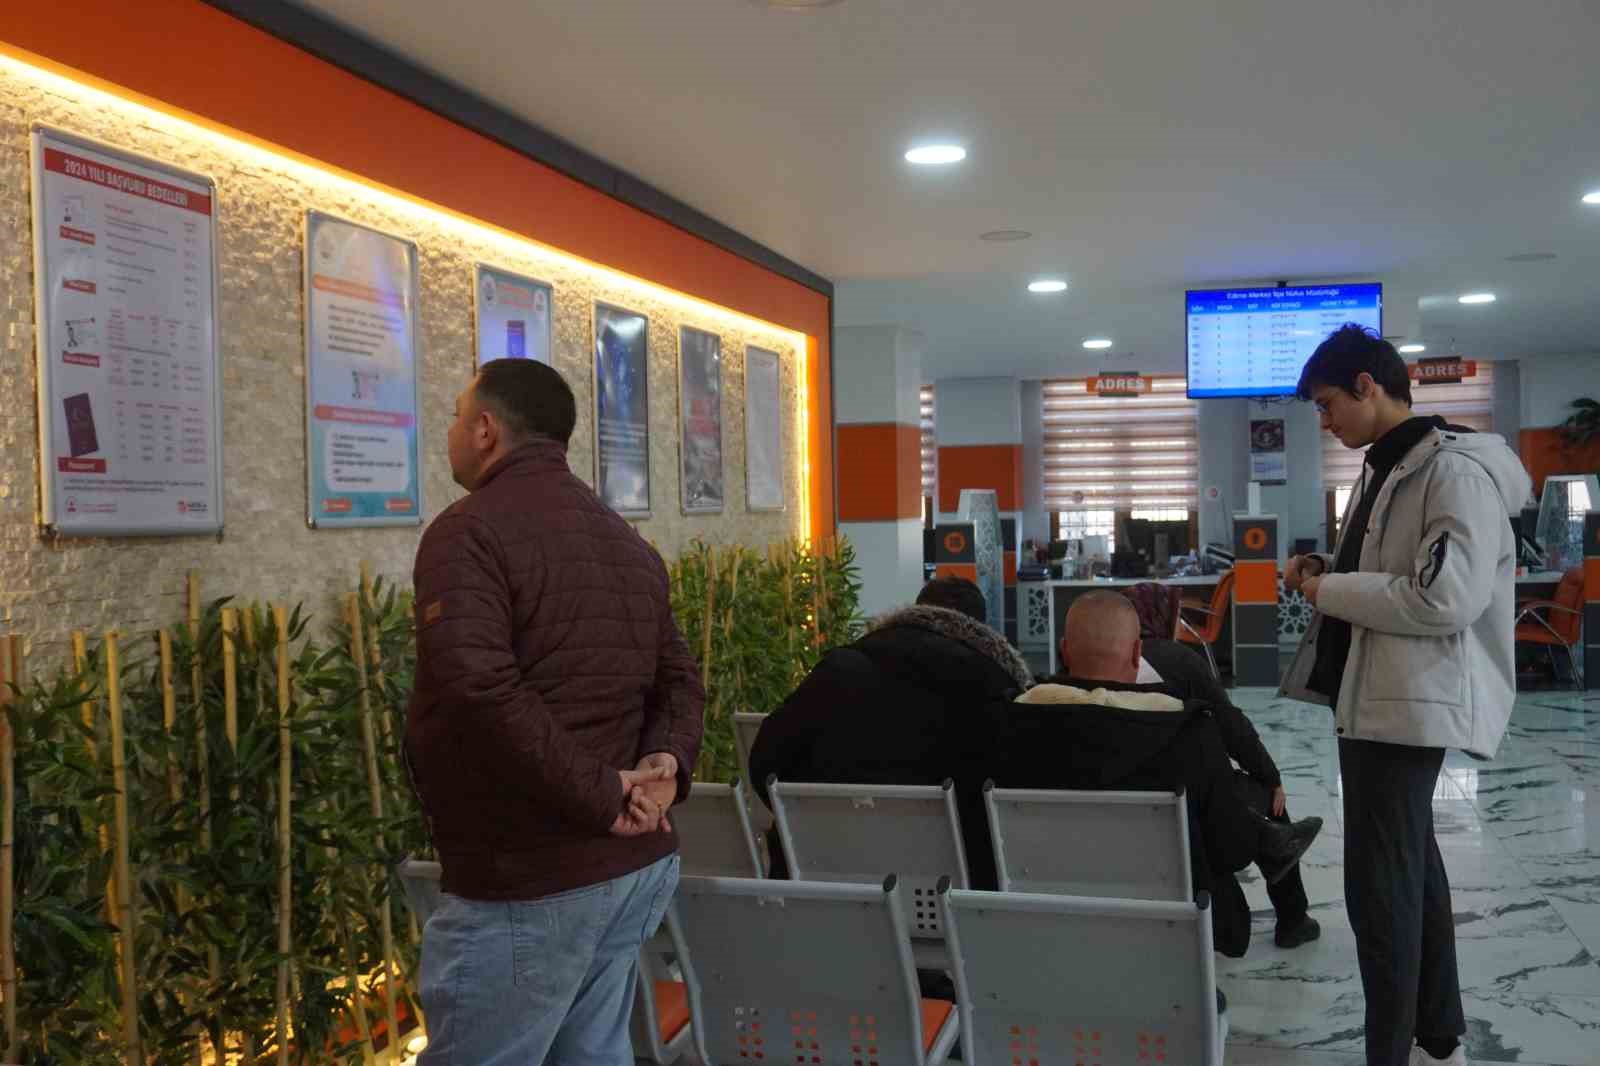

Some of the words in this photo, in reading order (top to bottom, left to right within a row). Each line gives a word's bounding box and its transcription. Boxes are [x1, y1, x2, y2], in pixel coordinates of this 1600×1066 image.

[64, 159, 87, 177] 2024
[1413, 363, 1468, 379] ADRES
[1095, 377, 1145, 392] ADRES
